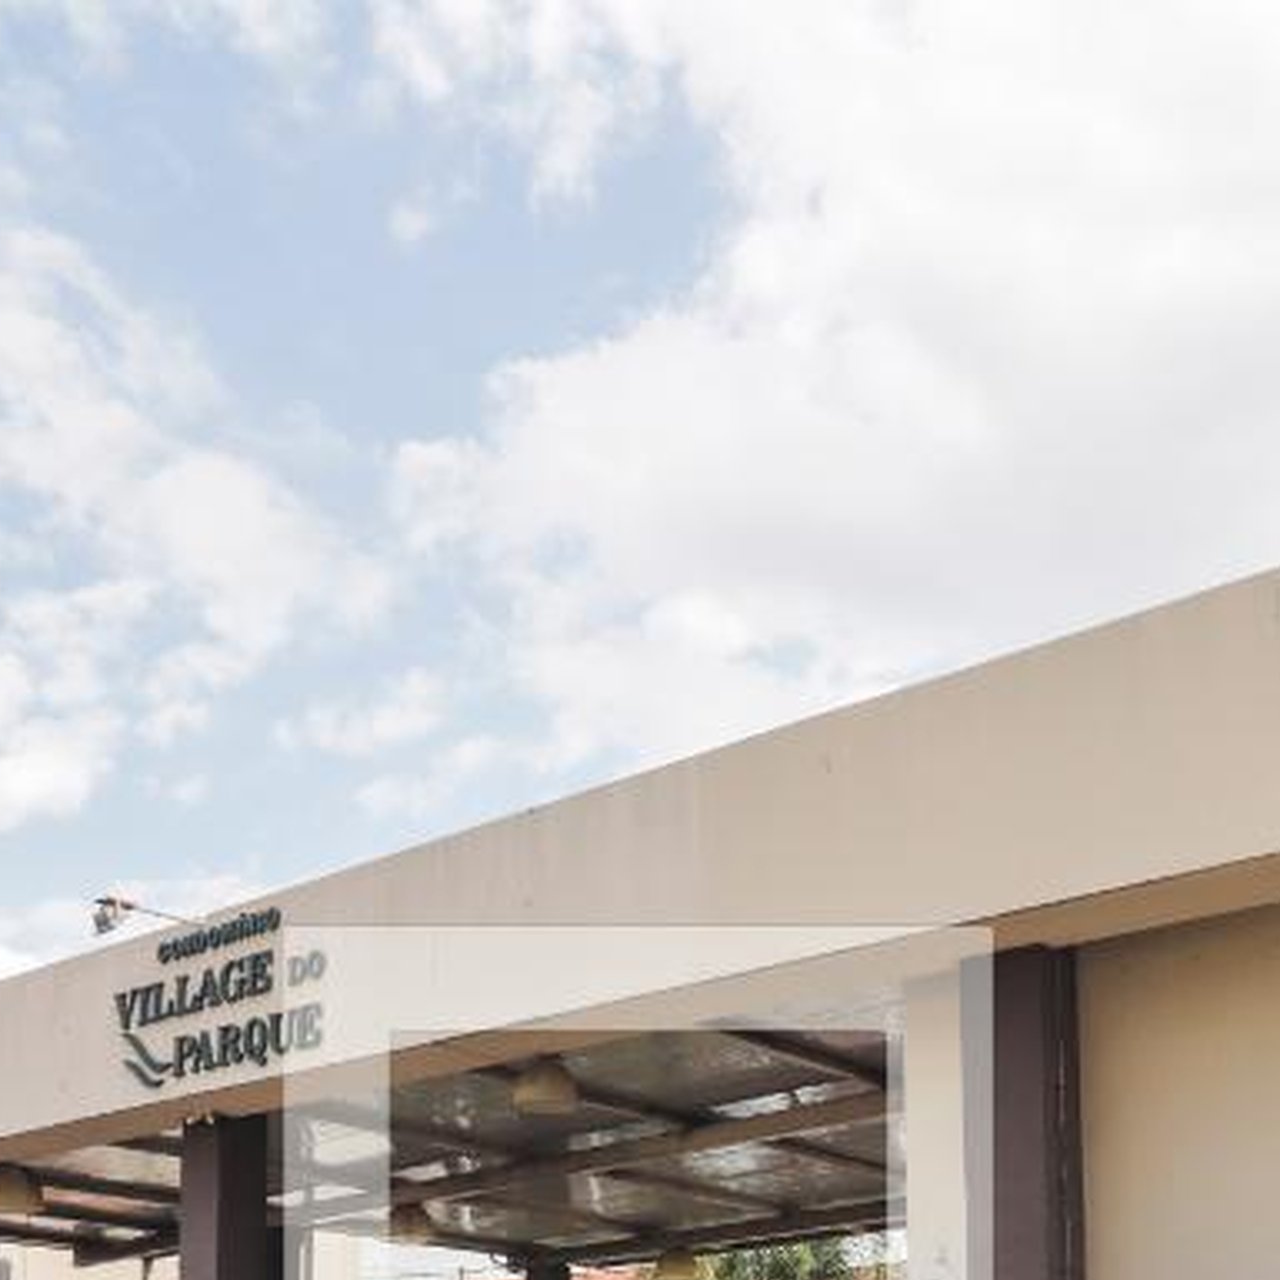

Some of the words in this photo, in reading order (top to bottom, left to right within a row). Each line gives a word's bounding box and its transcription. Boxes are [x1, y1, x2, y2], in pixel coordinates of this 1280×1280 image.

[113, 950, 274, 1031] VILLAGE
[287, 949, 327, 988] DO
[172, 1002, 323, 1078] PARQUE
